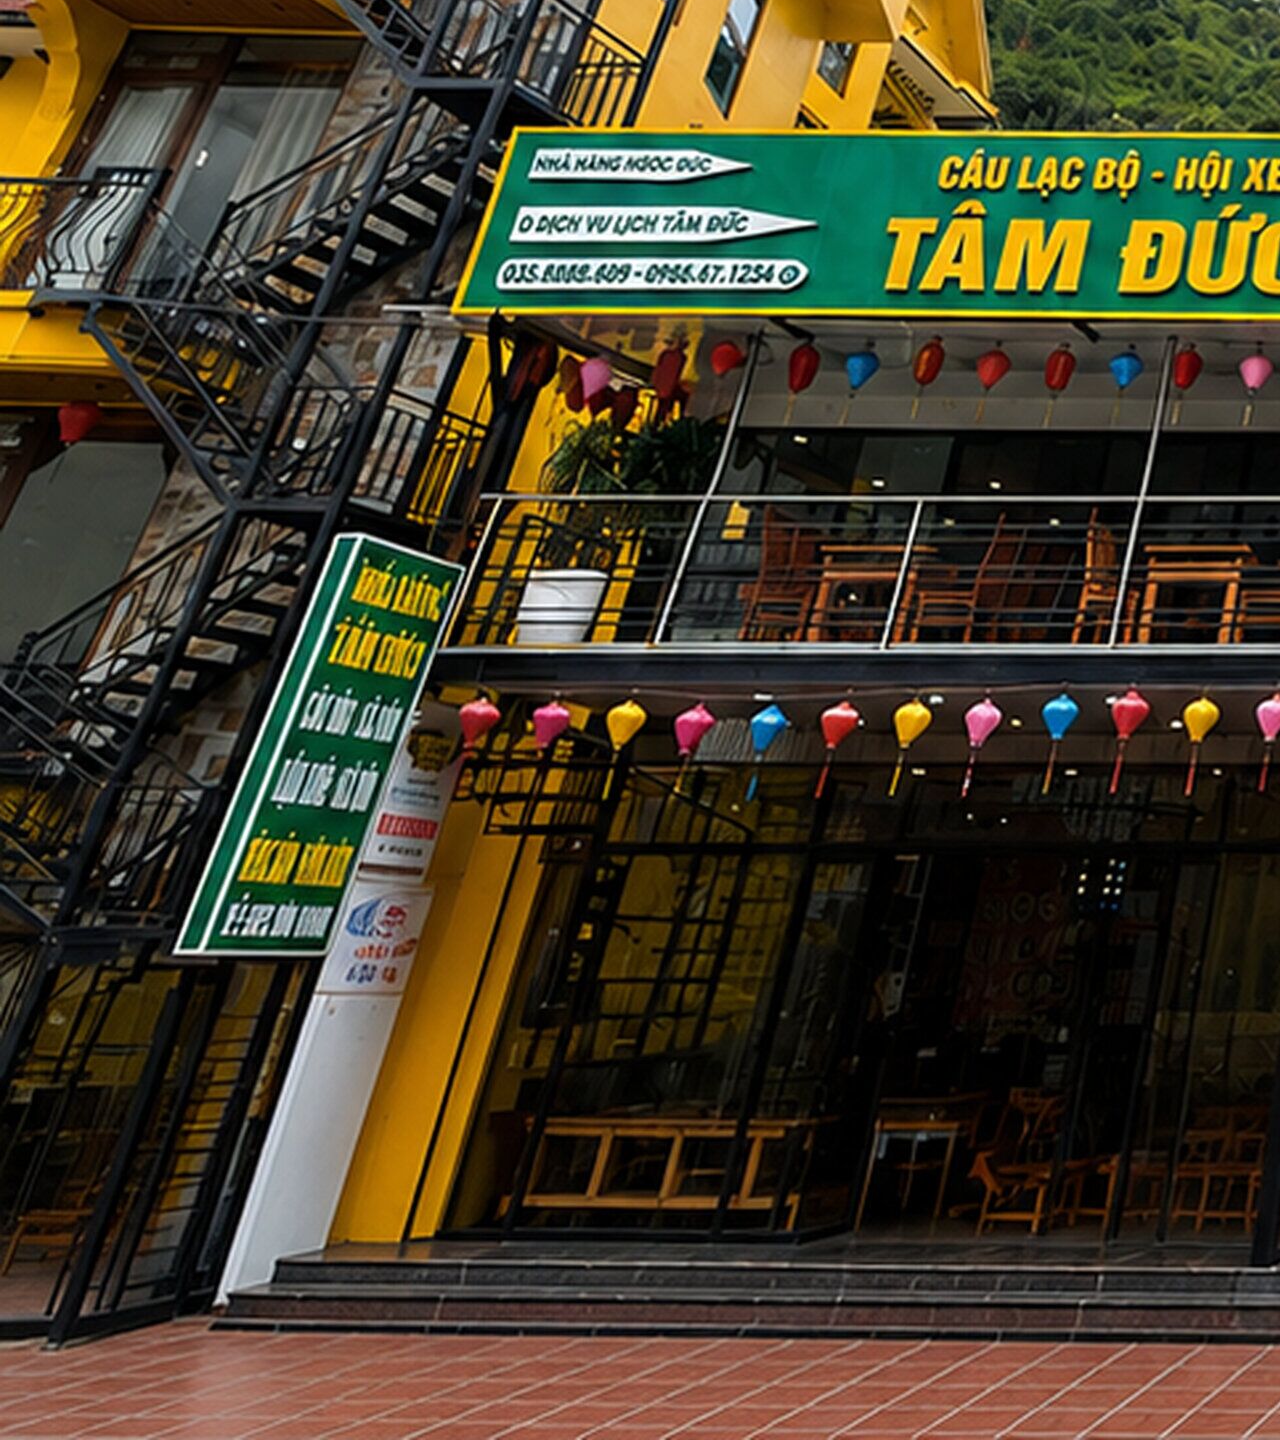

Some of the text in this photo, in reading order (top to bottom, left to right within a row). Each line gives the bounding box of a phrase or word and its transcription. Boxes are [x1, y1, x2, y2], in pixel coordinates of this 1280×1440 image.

[1016, 156, 1085, 200] LẠC
[1092, 149, 1141, 200] BỘ
[1173, 150, 1232, 199] HỘI
[885, 200, 1092, 291] TÂM
